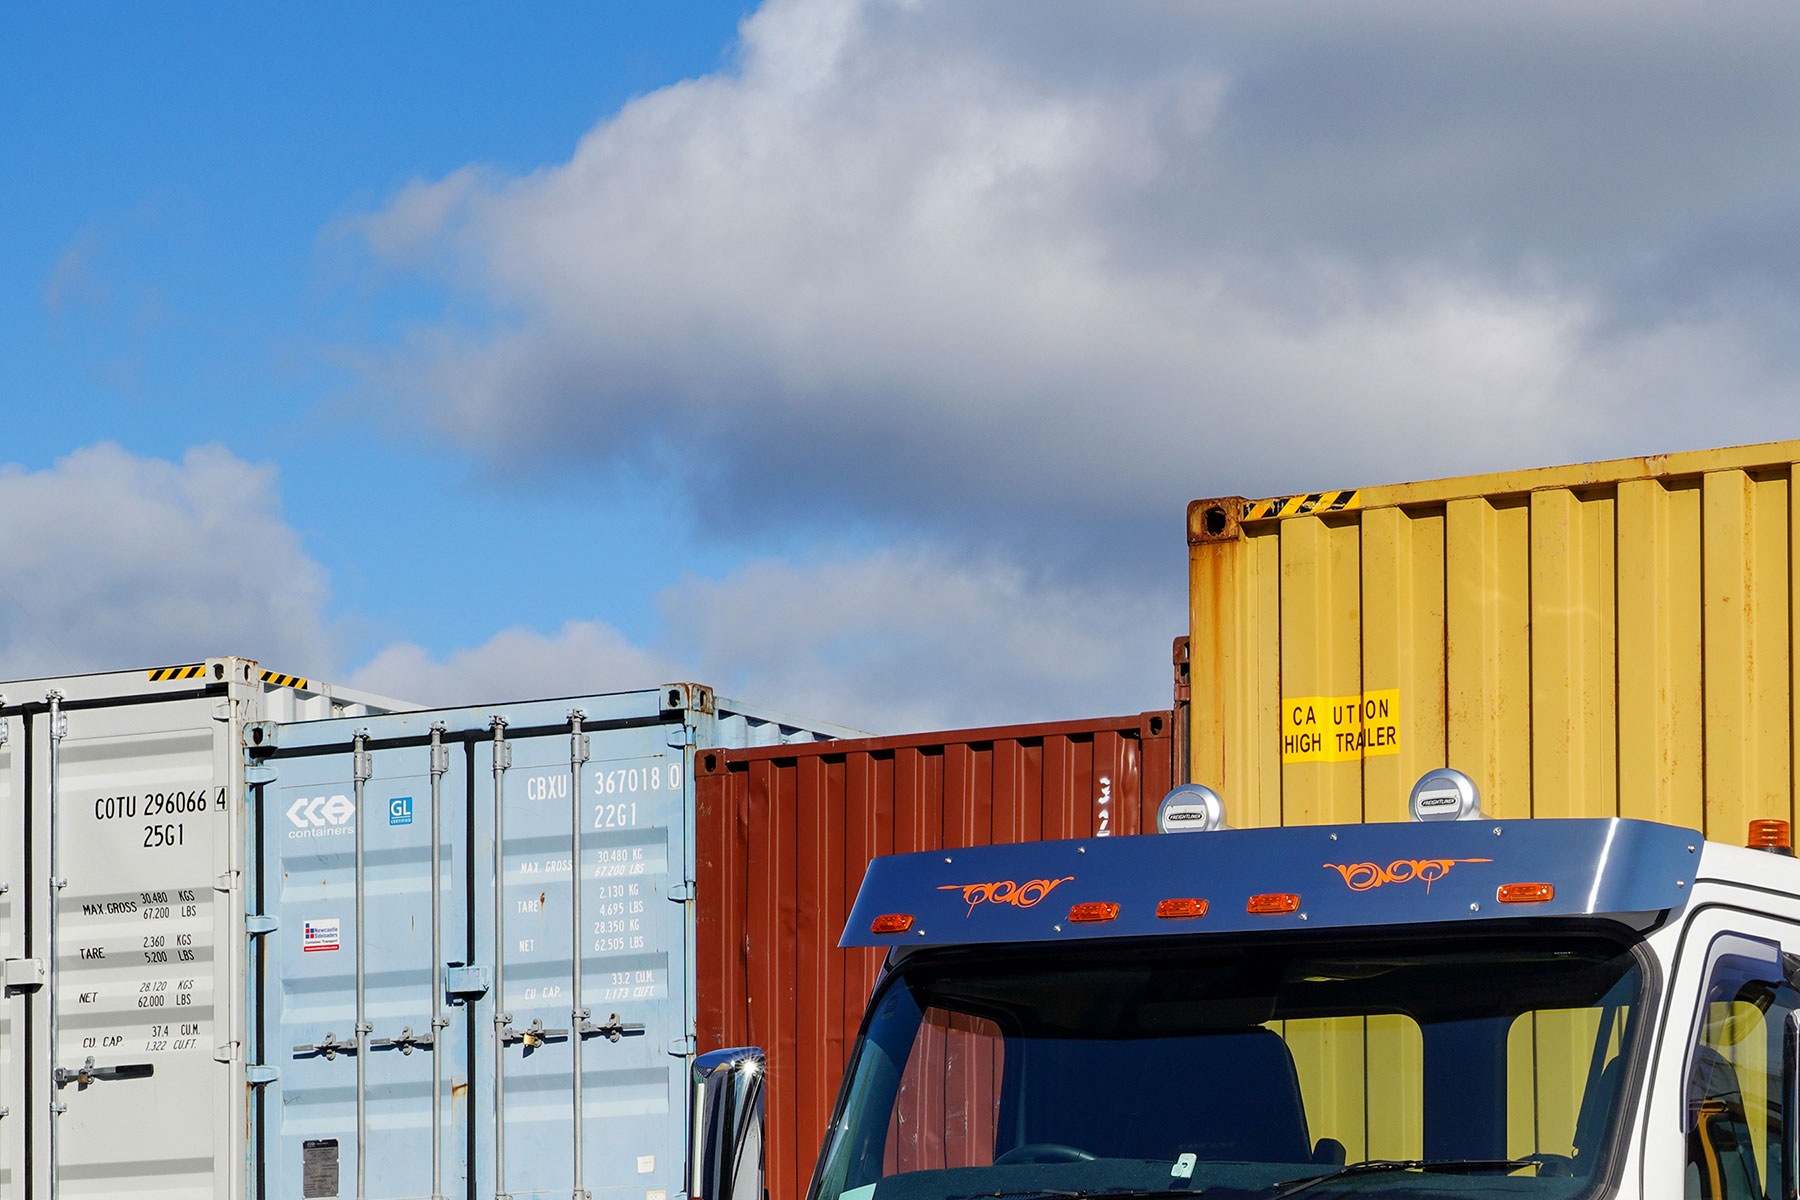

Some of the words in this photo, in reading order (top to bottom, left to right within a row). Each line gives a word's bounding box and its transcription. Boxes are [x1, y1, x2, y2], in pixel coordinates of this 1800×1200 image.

[1285, 733, 1322, 754] HIGH
[1336, 726, 1397, 753] TRAILER
[527, 774, 568, 801] CBXU
[595, 767, 661, 795] 367018
[670, 765, 681, 788] 0
[95, 796, 136, 820] COTU
[144, 790, 207, 816] 296066
[216, 787, 226, 810] 4
[390, 799, 412, 817] GL
[1423, 798, 1455, 806] FREIGHTLINER
[594, 803, 637, 829] 22G1
[1170, 813, 1202, 821] FREIGHTLINER
[143, 823, 183, 848] 25G1
[288, 826, 354, 839] containers
[598, 849, 628, 864] 30.480
[632, 848, 643, 861] KG
[545, 860, 573, 873] GROSS
[594, 865, 626, 877] 67.200
[629, 863, 645, 875] LBS
[140, 891, 168, 904] 30.480
[178, 890, 195, 902] KGS
[600, 885, 624, 899] 2.130
[629, 884, 639, 895] KG
[143, 907, 169, 920] 67.200
[181, 905, 197, 918] LBS
[518, 900, 539, 913] TARE
[600, 903, 624, 917] 4.695
[629, 902, 644, 913] LBS
[595, 920, 625, 934] 28.350
[629, 919, 640, 931] KG
[143, 935, 165, 948] 2.360
[176, 934, 192, 946] KGS
[519, 939, 534, 952] NET
[595, 938, 624, 951] 62.505
[629, 936, 644, 949] LBS
[79, 947, 105, 960] TARE
[144, 951, 168, 964] 5.200
[177, 950, 195, 962] LBS
[139, 981, 168, 993] 28.120
[177, 979, 194, 990] KGS
[612, 973, 630, 985] 33.2
[78, 992, 98, 1004] NET
[138, 995, 165, 1008] 62.000
[176, 994, 191, 1006] LBS
[152, 1025, 169, 1038] 37.4
[82, 1037, 97, 1048] CU.
[102, 1036, 124, 1047] CAP.
[145, 1040, 167, 1052] 1.322
